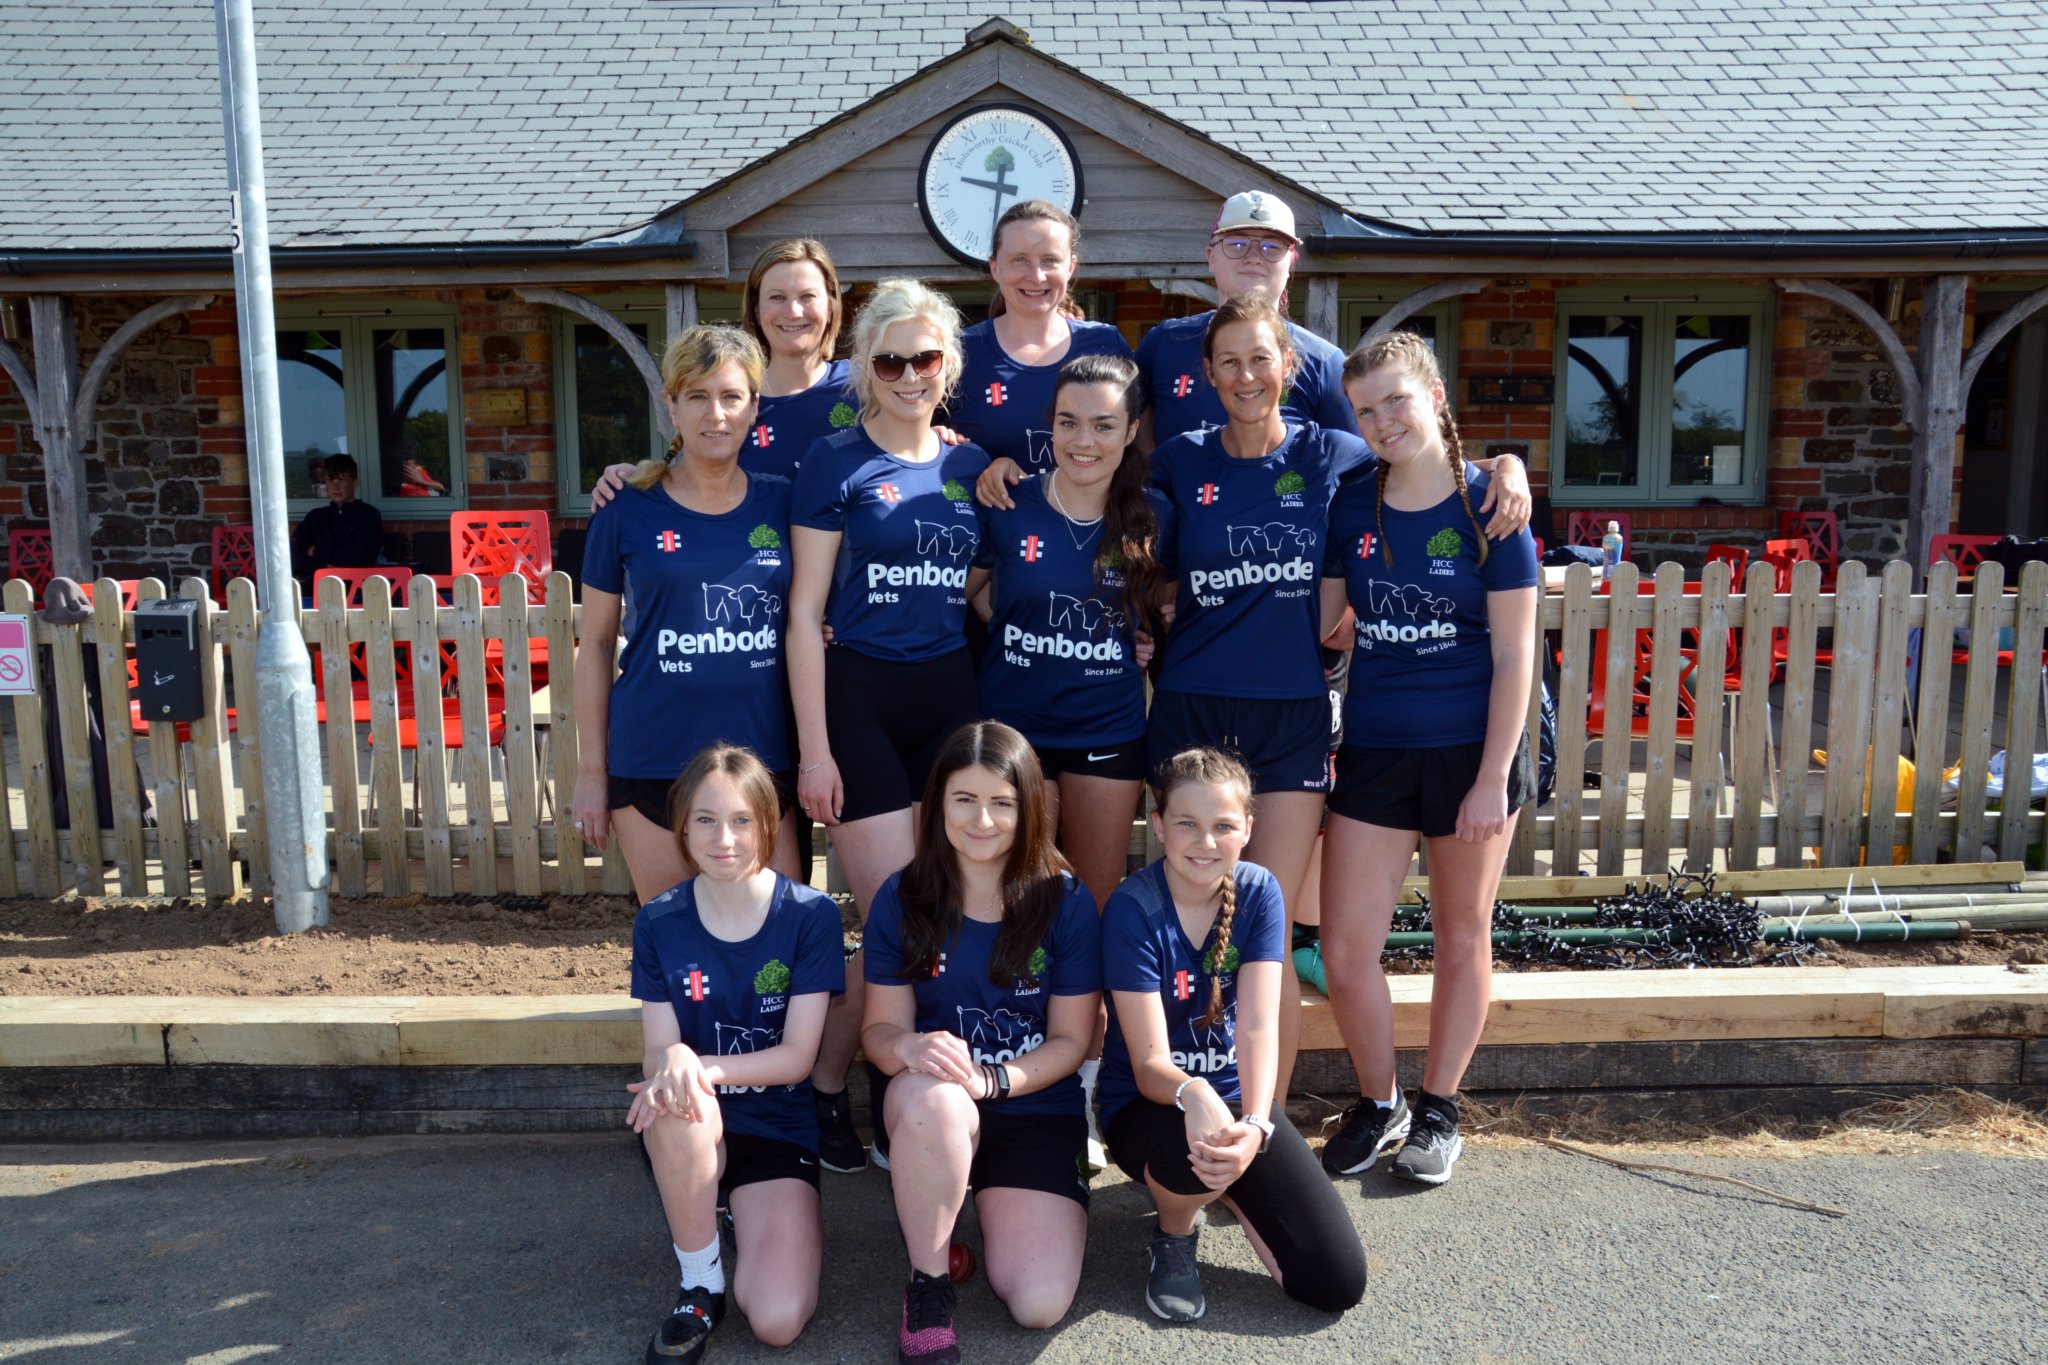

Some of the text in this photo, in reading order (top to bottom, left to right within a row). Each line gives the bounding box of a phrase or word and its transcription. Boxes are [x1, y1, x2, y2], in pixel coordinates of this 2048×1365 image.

[955, 135, 1046, 170] Holsworthy Cricket Club
[1282, 493, 1302, 501] HCC
[759, 550, 779, 558] HCC
[1432, 559, 1454, 568] HCC
[867, 560, 968, 589] Penbod
[1190, 556, 1314, 595] Penbode
[1429, 568, 1455, 576] LADIES
[1275, 589, 1296, 598] Since
[657, 624, 777, 656] Penbode
[1004, 623, 1123, 661] Penbode
[1416, 645, 1438, 656] Since
[1439, 640, 1457, 650] 1840
[659, 659, 693, 673] Vets
[750, 659, 766, 669] Since
[1004, 650, 1123, 676] Vets Since 1840
[762, 995, 785, 1005] HCC
